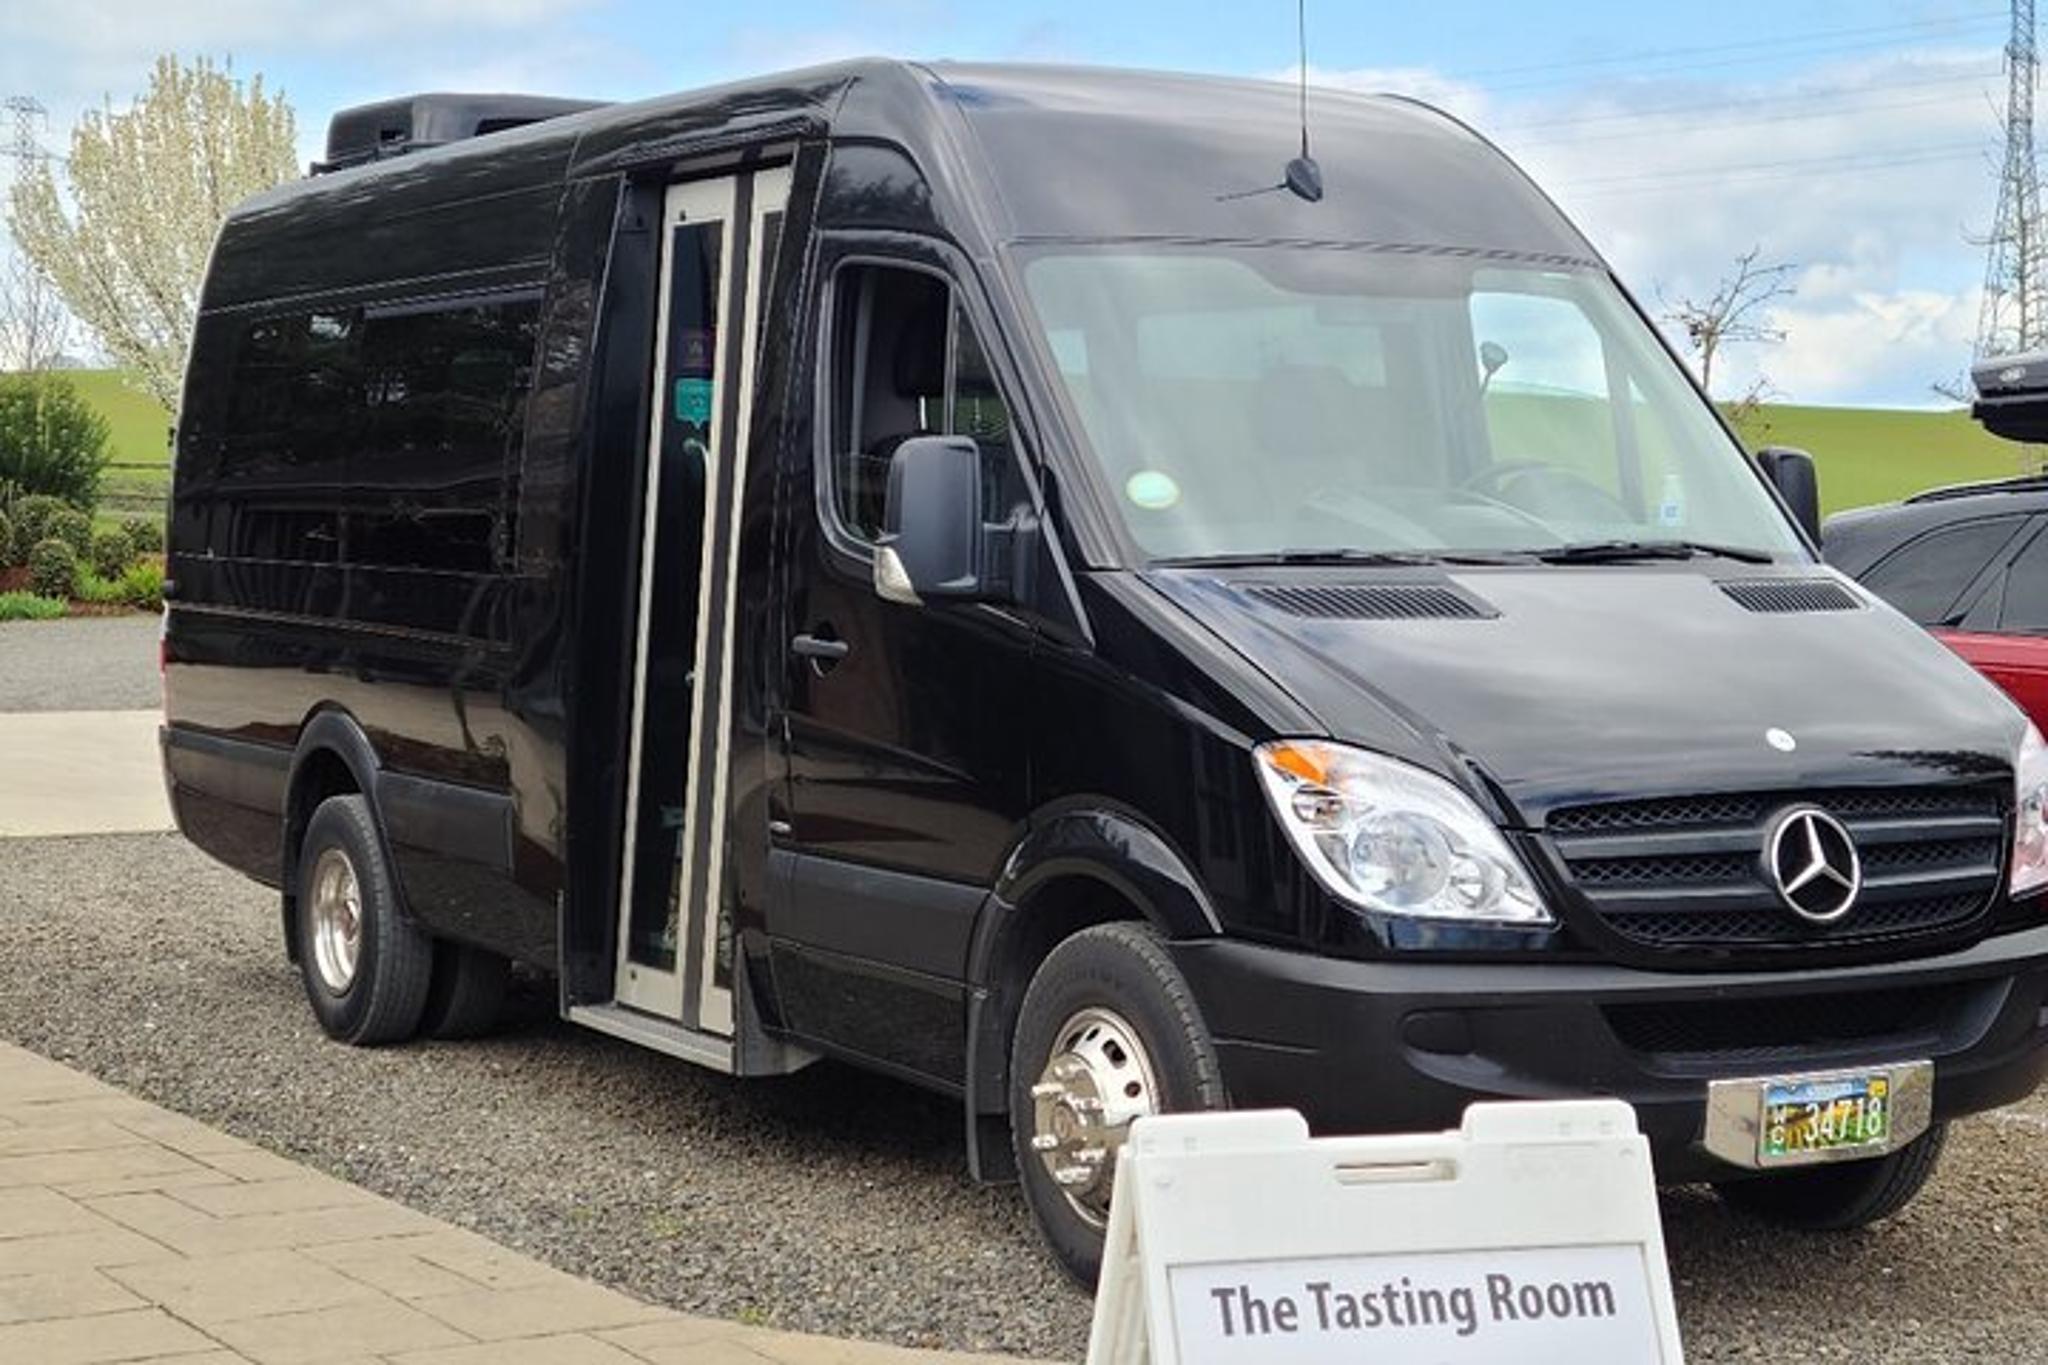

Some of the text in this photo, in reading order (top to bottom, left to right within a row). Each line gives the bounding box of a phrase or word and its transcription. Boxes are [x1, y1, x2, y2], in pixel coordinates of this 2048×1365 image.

[1804, 1097, 1881, 1142] 34718
[1211, 1272, 1617, 1336] The Tasting Room
